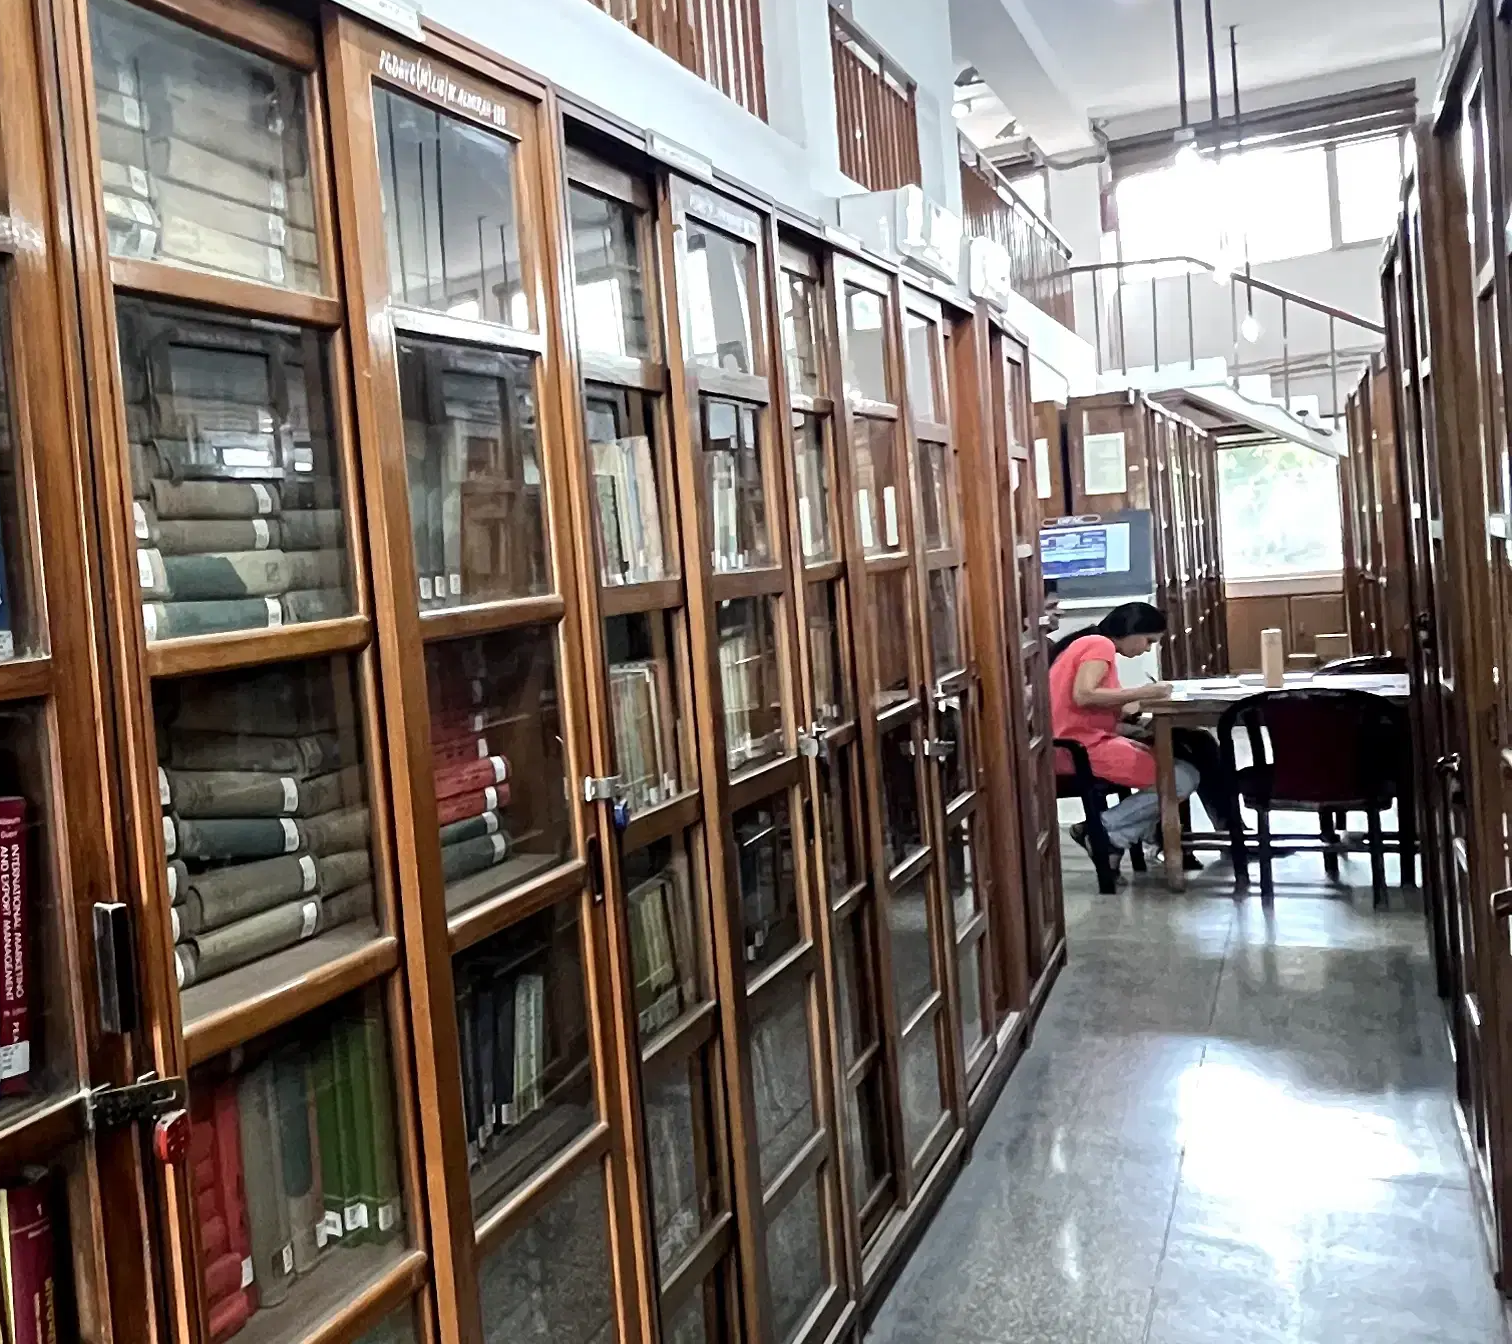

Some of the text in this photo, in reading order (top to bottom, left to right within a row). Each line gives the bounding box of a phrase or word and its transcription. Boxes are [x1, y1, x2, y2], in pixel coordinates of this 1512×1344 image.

[0, 846, 16, 1002] AND EXPORT MANAGEMENT
[11, 844, 24, 927] INTERNATIONAL
